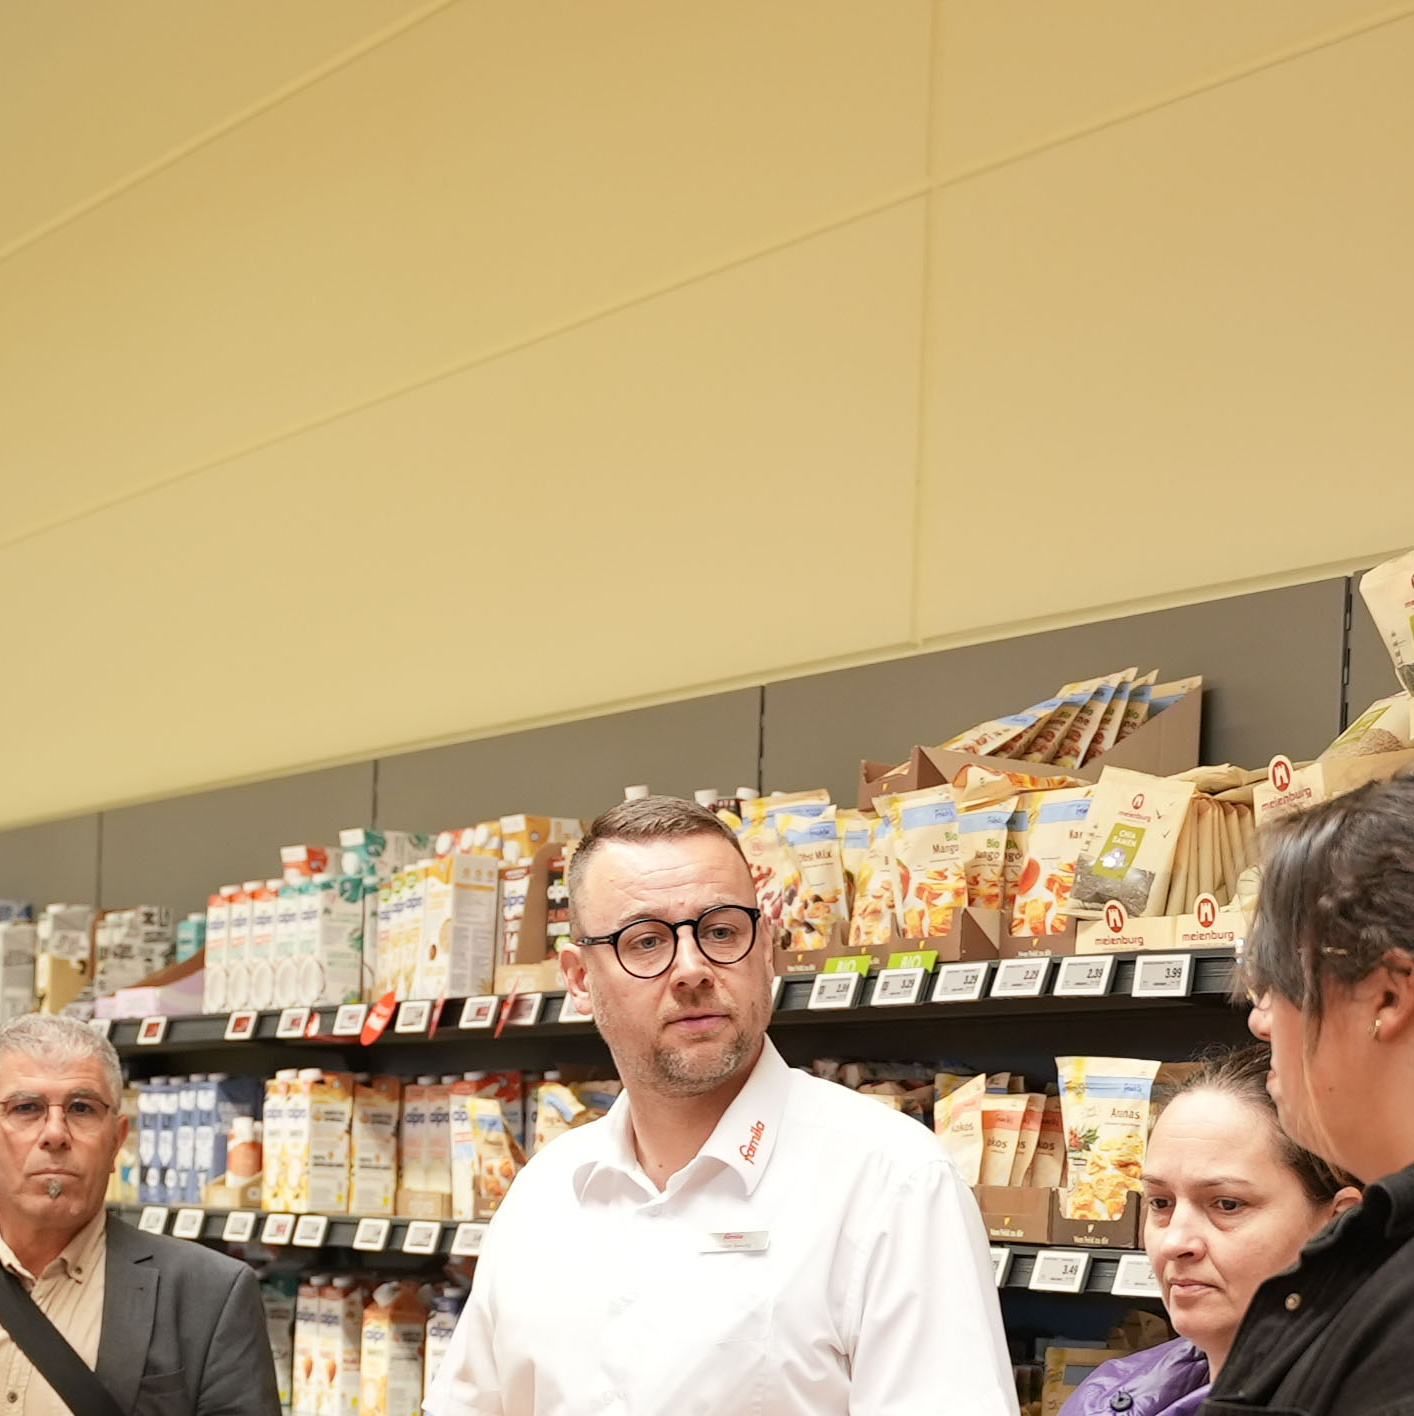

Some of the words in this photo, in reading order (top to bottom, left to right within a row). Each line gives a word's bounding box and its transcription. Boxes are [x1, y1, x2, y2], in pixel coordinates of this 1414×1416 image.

[1261, 787, 1312, 811] meienburg
[945, 831, 958, 842] Bio
[1094, 934, 1145, 948] meienburg
[1182, 930, 1235, 944] meienburg
[1087, 967, 1103, 980] 2.39
[1165, 967, 1182, 979] 3.99
[739, 1121, 765, 1165] famila
